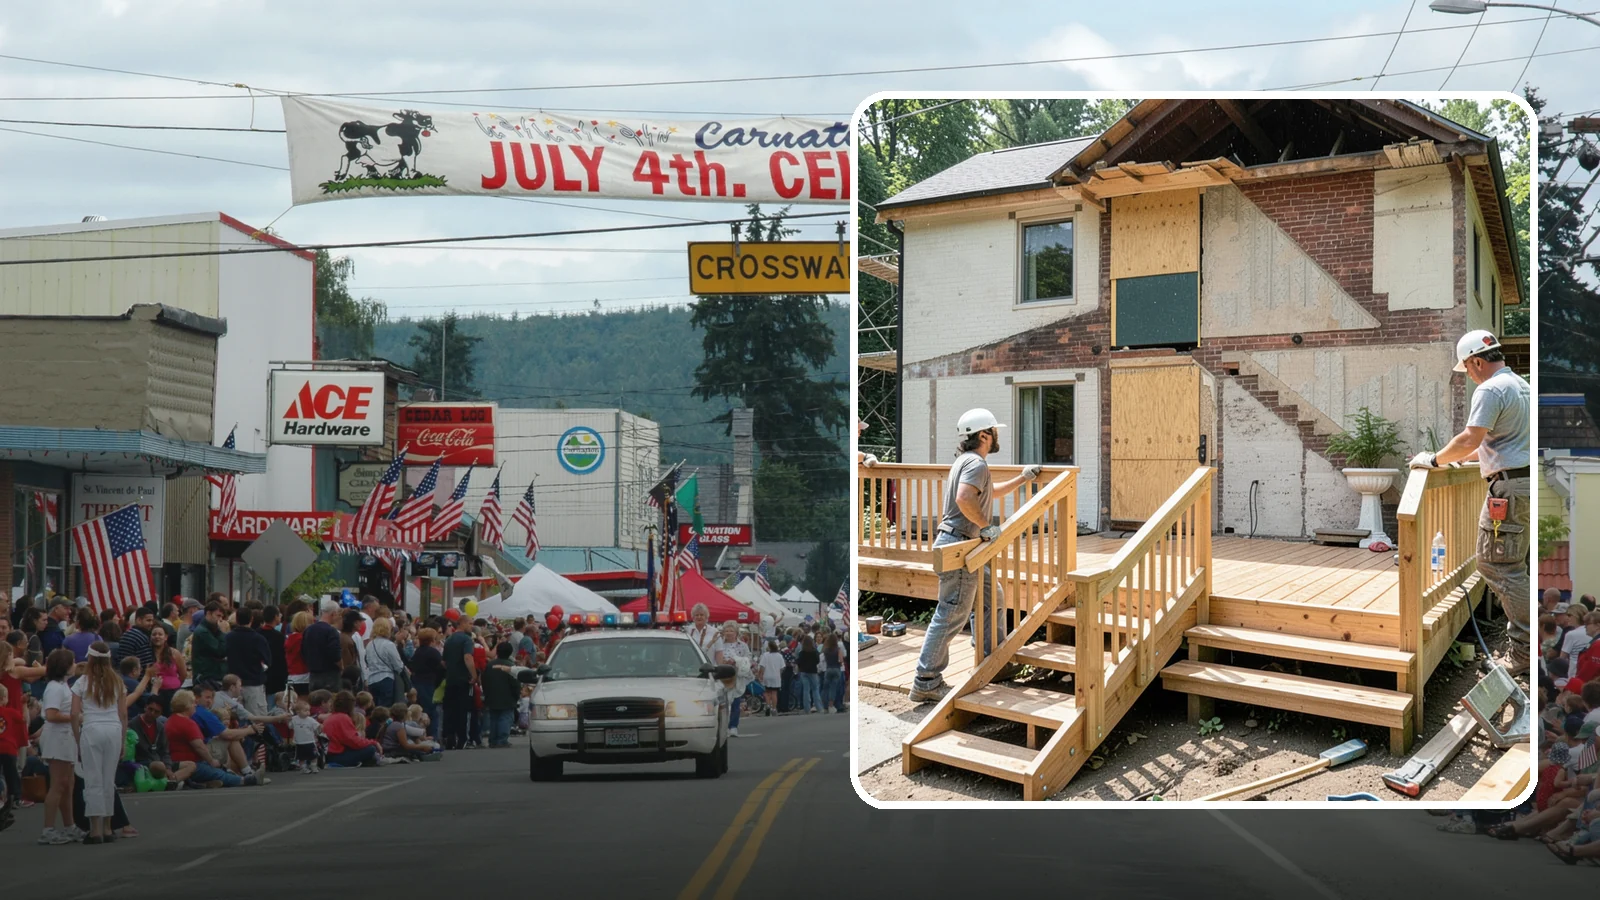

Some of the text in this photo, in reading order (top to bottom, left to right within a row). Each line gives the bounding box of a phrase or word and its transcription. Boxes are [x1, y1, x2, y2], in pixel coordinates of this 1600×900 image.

[481, 141, 604, 193] JULY
[632, 150, 746, 198] 4th.
[697, 254, 850, 280] CROSSWA
[283, 380, 373, 420] ACE
[405, 409, 485, 421] CEDAR LOG
[283, 421, 371, 436] Hardware
[353, 467, 386, 479] Simpl
[83, 485, 155, 495] St. Vincent de Paul
[80, 503, 154, 521] THT
[212, 516, 331, 535] HARDARE
[688, 526, 741, 535] CRNATION
[699, 535, 730, 543] GLASS
